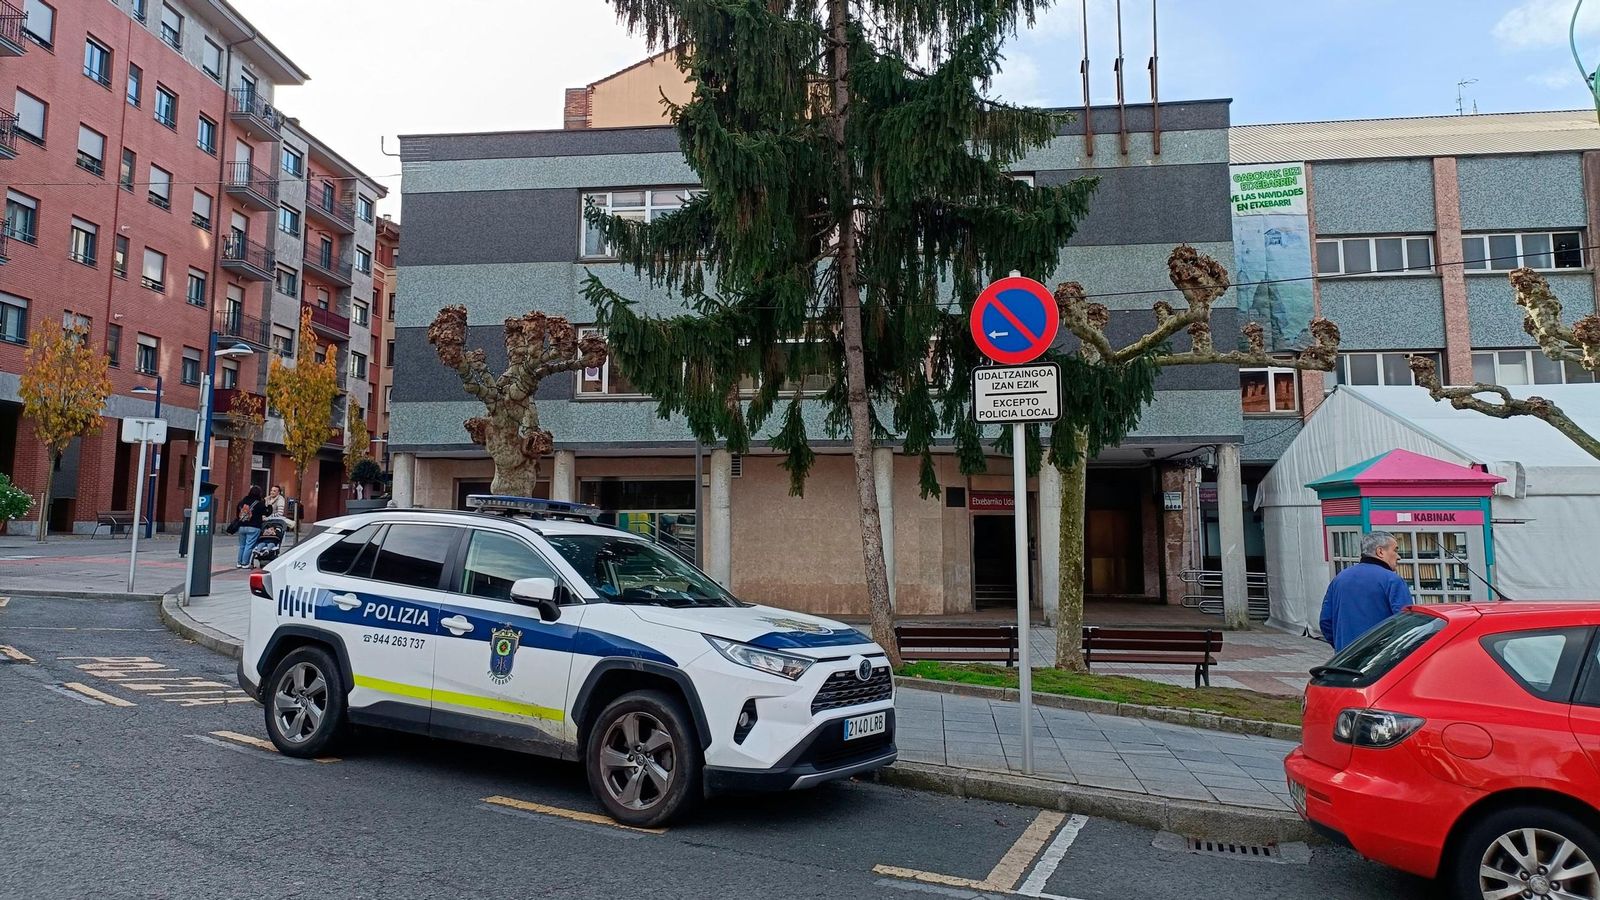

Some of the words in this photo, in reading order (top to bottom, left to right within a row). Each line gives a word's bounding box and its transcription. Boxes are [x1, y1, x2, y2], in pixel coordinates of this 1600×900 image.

[1233, 169, 1282, 183] GABONAK
[1283, 167, 1302, 177] BIZI
[1240, 177, 1297, 191] ETXEBARRIN
[1241, 193, 1257, 201] LAS
[1258, 188, 1304, 199] NAVIDADES
[1237, 203, 1248, 211] EN
[1250, 199, 1291, 209] ETXEBARRI
[977, 369, 1054, 380] UDALTZAINGOA
[992, 382, 1014, 390] IZAN
[1017, 380, 1039, 389] EZIK
[993, 398, 1039, 407] EXCEPTO
[979, 409, 1018, 418] POLICIA
[1021, 408, 1055, 417] LOCAL
[199, 496, 206, 507] P
[1414, 513, 1456, 522] KABINAK
[363, 602, 429, 627] POLIZIA
[373, 633, 390, 645] 944
[392, 635, 408, 648] 263
[410, 638, 425, 649] 737
[849, 719, 868, 737] 2140
[870, 715, 883, 731] LRB
